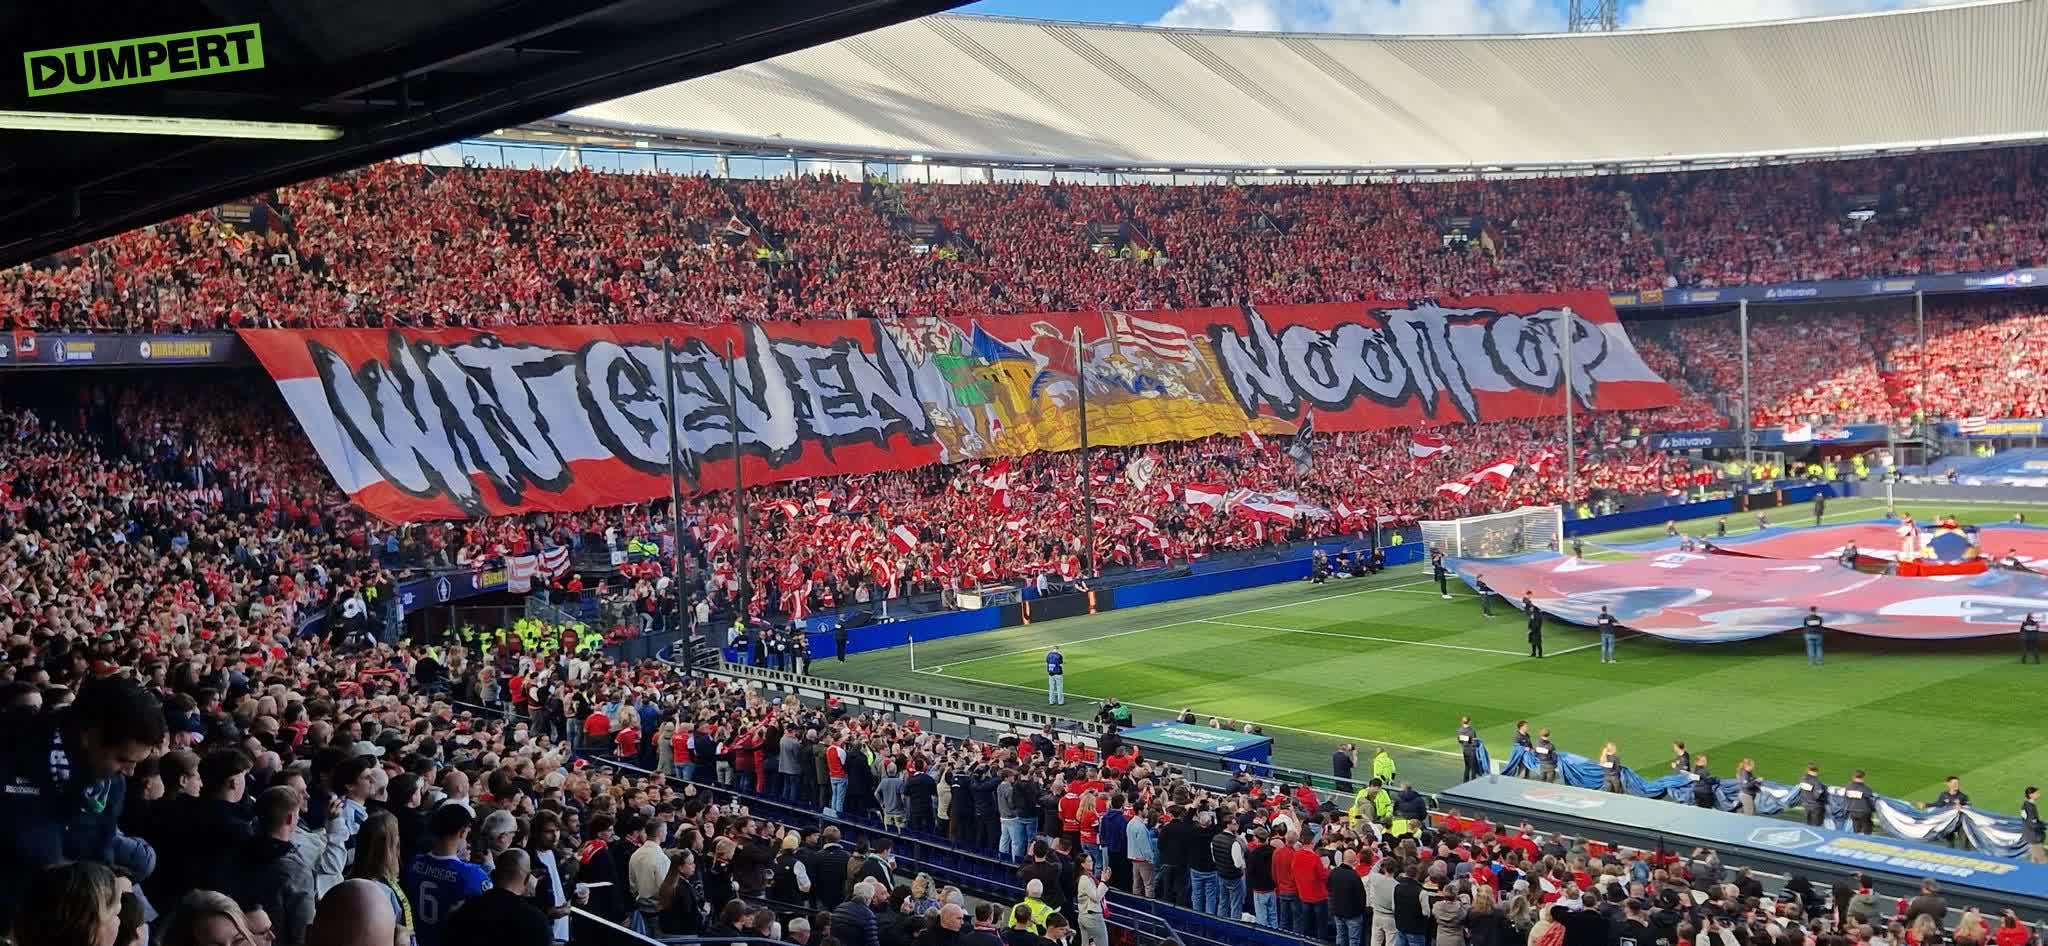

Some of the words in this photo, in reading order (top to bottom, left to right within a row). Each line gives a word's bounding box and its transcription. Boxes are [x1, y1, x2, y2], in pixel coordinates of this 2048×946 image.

[576, 317, 933, 488] GEVEN
[1206, 298, 1497, 424] NOOIT
[1484, 309, 1606, 411] OP
[1671, 437, 1712, 448] bitvavo
[419, 881, 438, 925] 6
